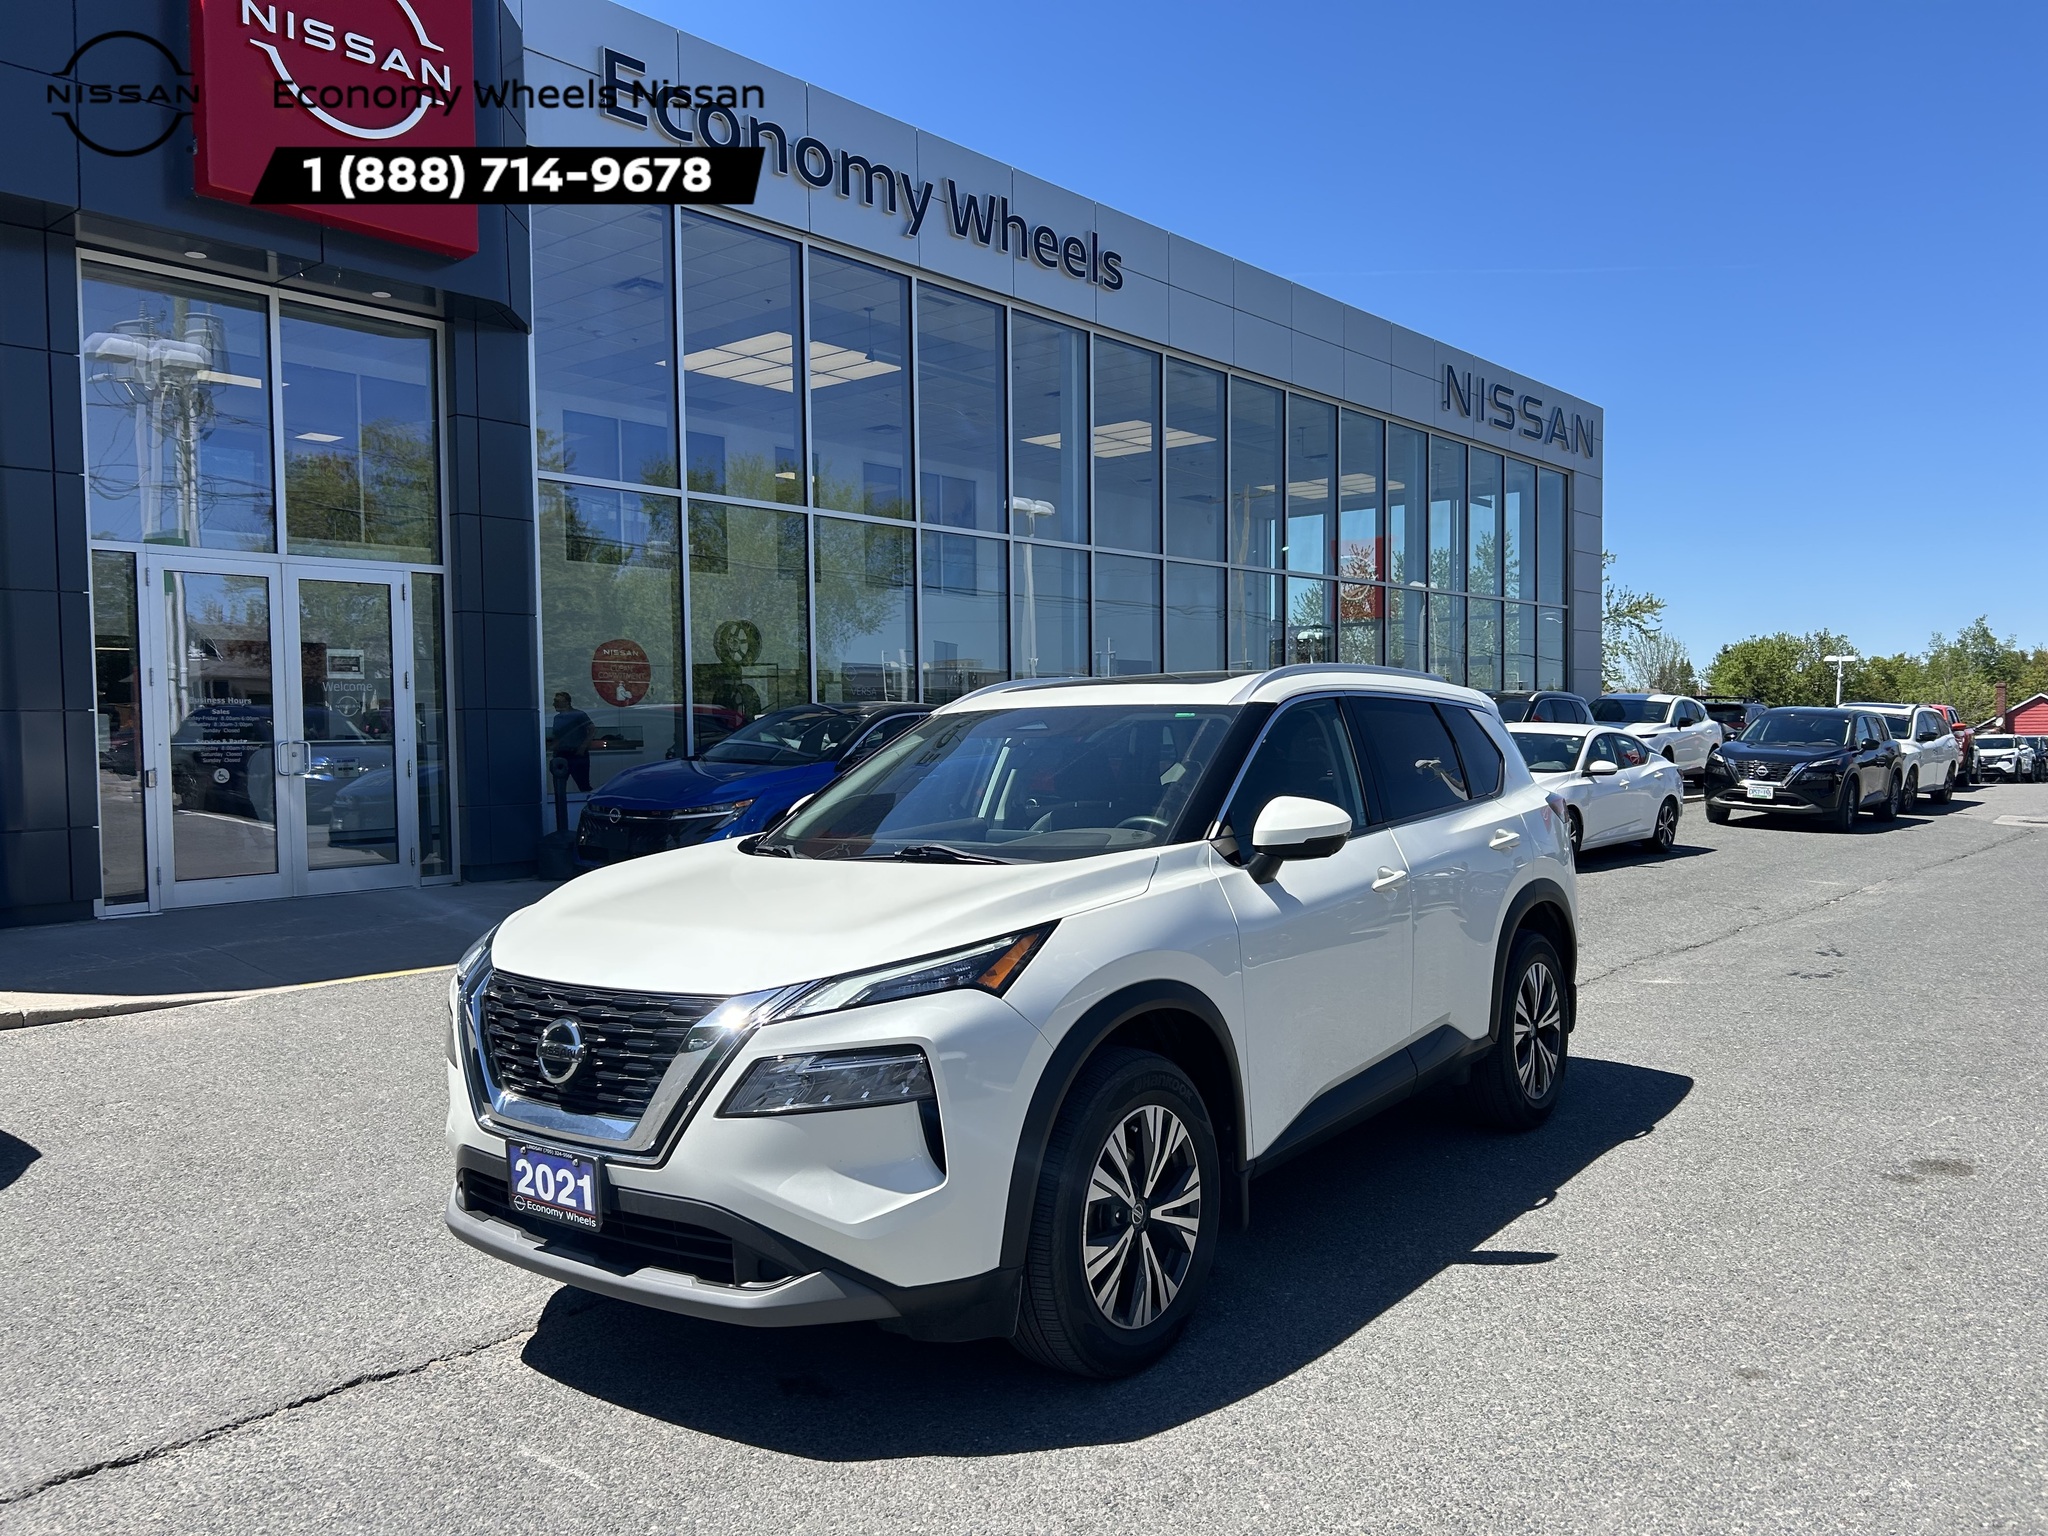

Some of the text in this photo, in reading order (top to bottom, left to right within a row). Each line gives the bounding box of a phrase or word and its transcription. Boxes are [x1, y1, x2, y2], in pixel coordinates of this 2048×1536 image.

[242, 0, 451, 92] NISSAN
[600, 45, 1125, 292] Economy Wheels
[1443, 363, 1594, 459] NISSAN
[322, 681, 373, 692] Welcome
[850, 686, 877, 696] VERSA
[514, 1158, 593, 1211] 2021
[527, 1200, 597, 1228] Economy Wheels
